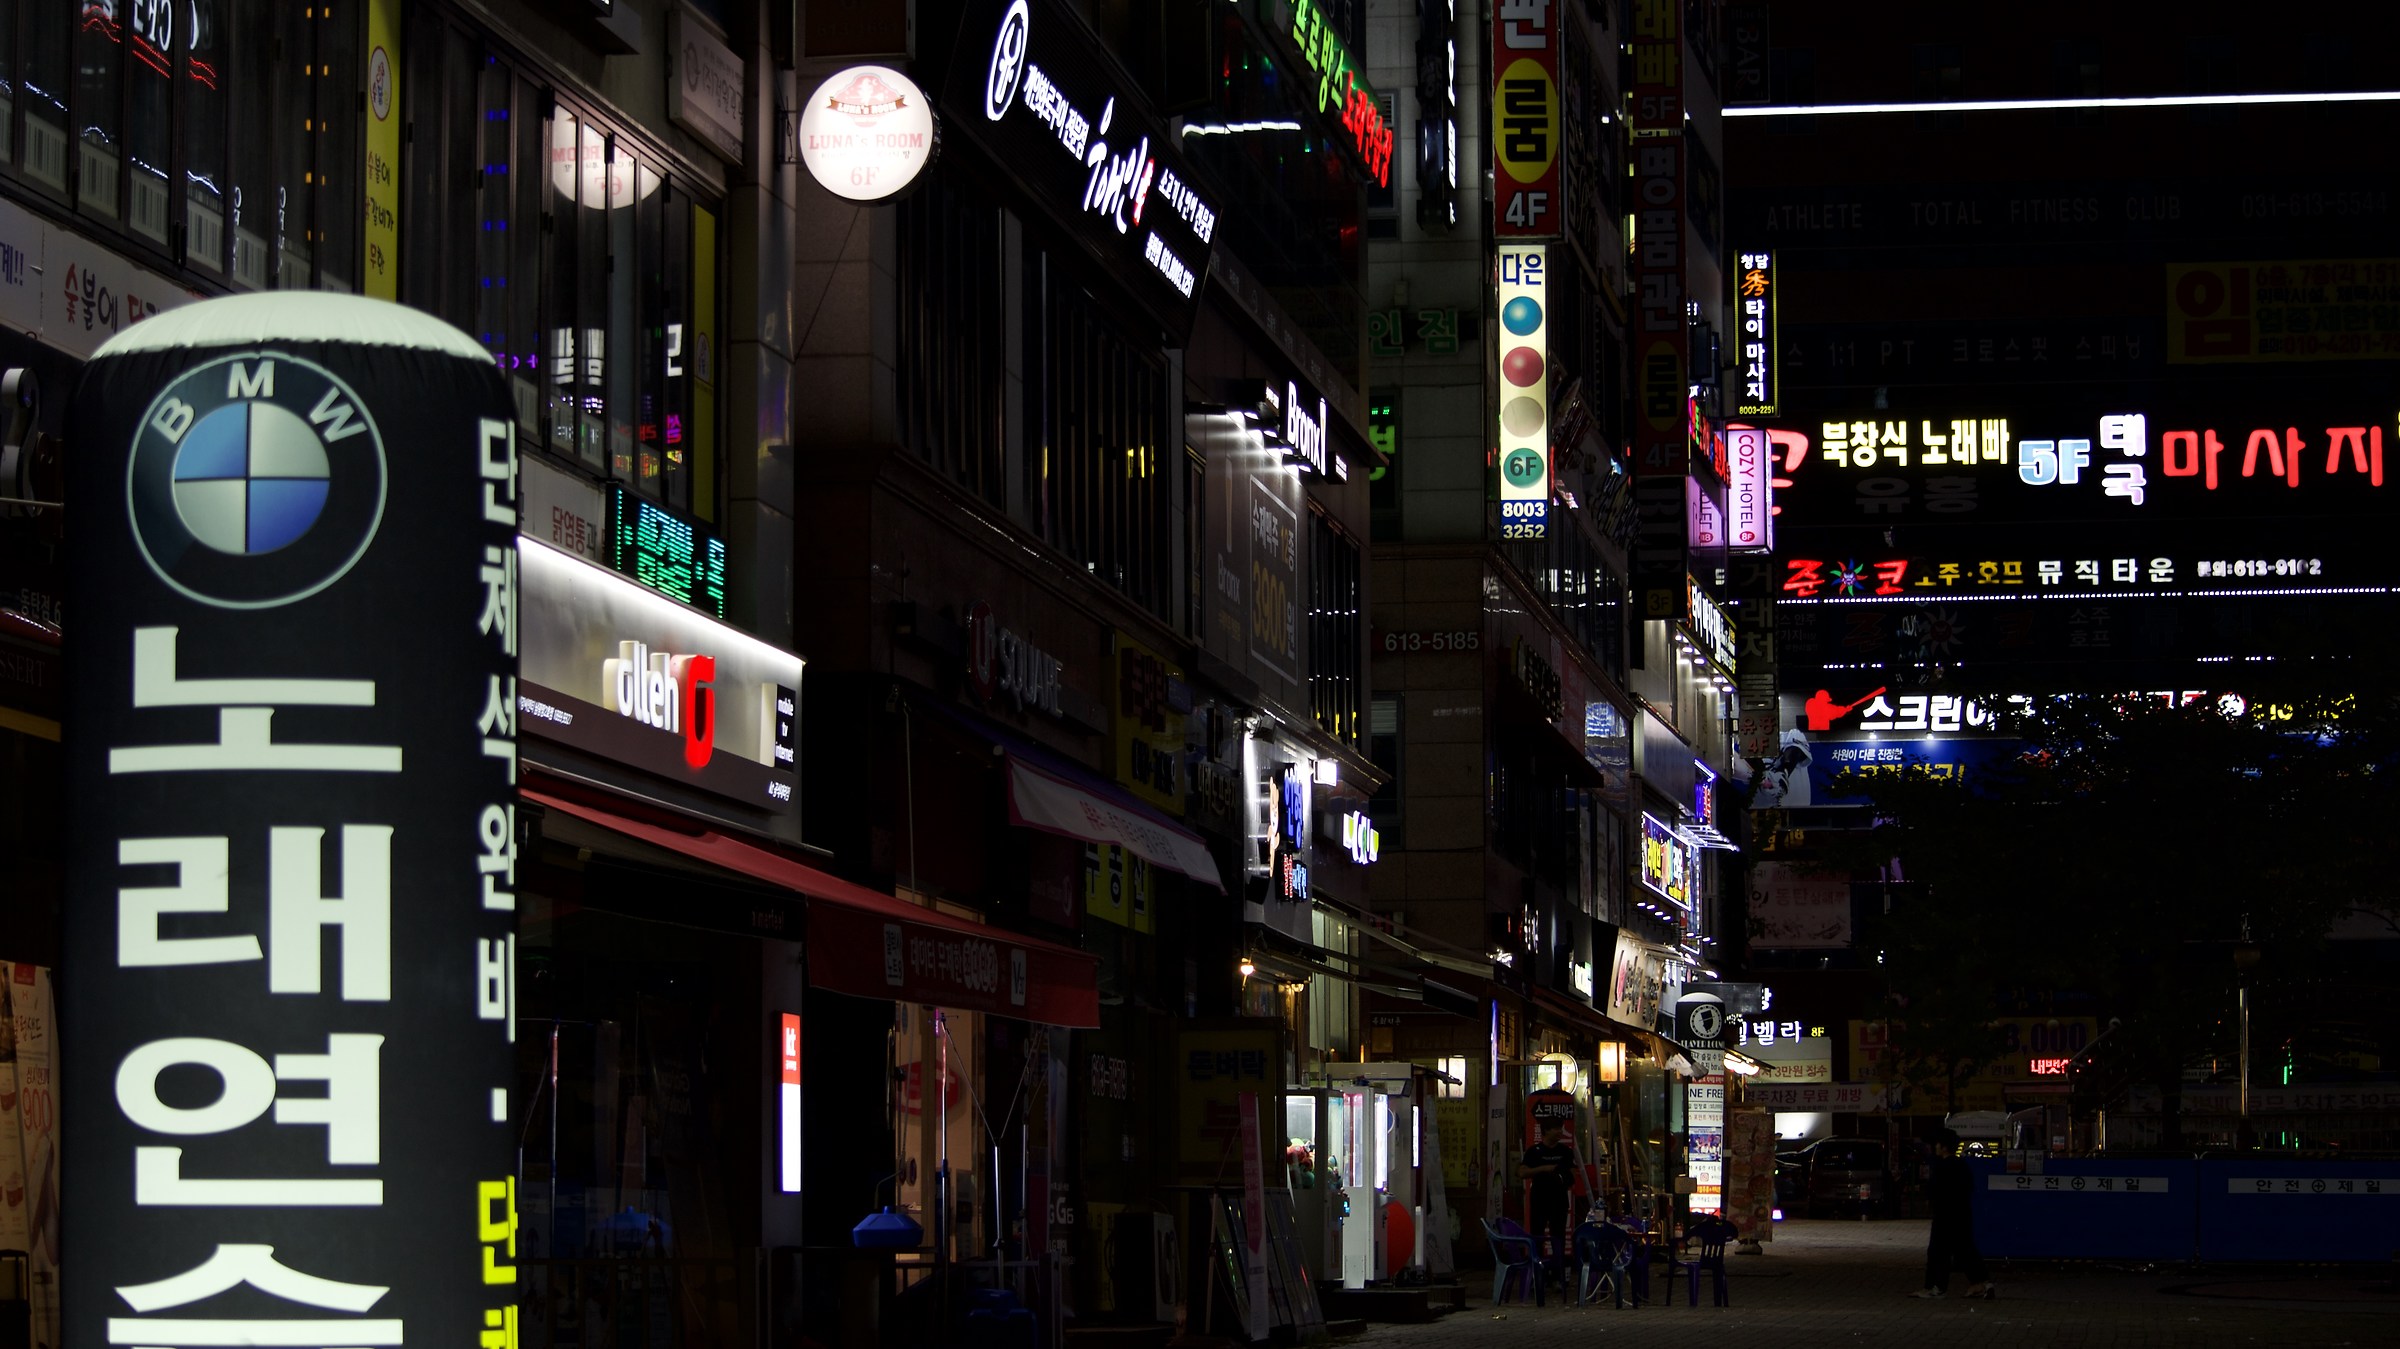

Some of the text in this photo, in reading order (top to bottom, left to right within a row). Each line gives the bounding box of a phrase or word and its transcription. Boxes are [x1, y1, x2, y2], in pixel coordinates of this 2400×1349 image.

[1505, 79, 1547, 161] 룸
[1641, 96, 1677, 120] 5F
[876, 133, 923, 148] ROOM
[1505, 191, 1547, 227] 4F
[1910, 200, 1983, 226] TOTAL
[2010, 197, 2100, 224] FITNESS
[2125, 196, 2183, 222] CLUB
[1502, 253, 1543, 285] 다은
[1740, 254, 1769, 270] 청담
[1740, 270, 1769, 297] 秀
[1745, 299, 1765, 339] 타이
[1745, 343, 1765, 402] 마사지
[151, 360, 367, 445] BMW
[1739, 405, 1774, 415] 8003-2251
[1287, 380, 1321, 471] Bronx
[1645, 443, 1682, 467] 4F
[1822, 418, 2091, 485] 북창식 노래빠 5F
[2100, 413, 2383, 505] 태국 마사지
[1509, 456, 1537, 477] 6F
[1739, 434, 1755, 529] COZY HOTEL
[1502, 502, 1546, 519] 8003
[1502, 524, 1546, 540] 3252
[1741, 532, 1753, 541] 8F
[1217, 552, 1241, 605] Bronx
[2037, 557, 2174, 586] 뮤직타운
[1740, 563, 1775, 664] 거래처
[1385, 632, 1480, 652] 613-5185
[605, 641, 679, 733] olleh
[1749, 740, 1770, 754] 4F
[1811, 1026, 1825, 1038] 8F
[1803, 1089, 1829, 1103] 무료
